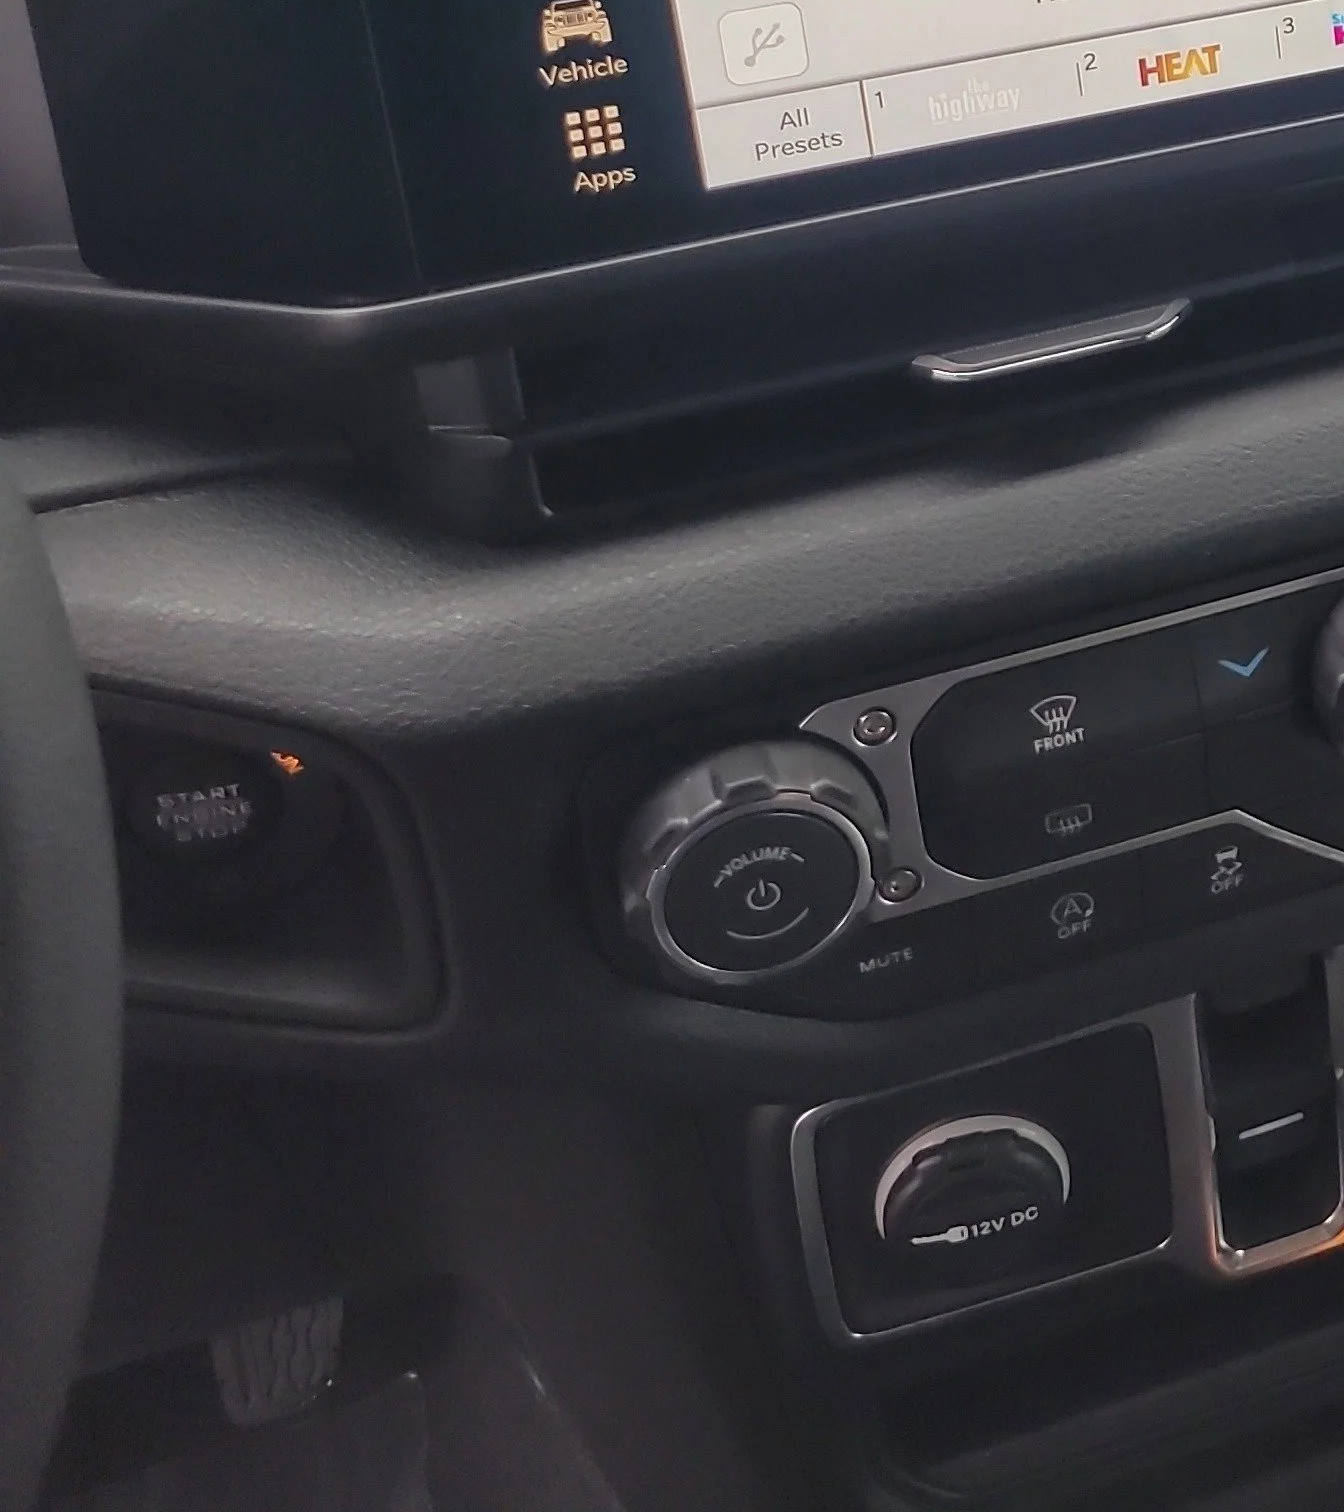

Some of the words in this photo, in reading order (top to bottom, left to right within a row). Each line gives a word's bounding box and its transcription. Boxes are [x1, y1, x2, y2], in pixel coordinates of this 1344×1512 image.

[1282, 17, 1295, 34] 3
[539, 54, 629, 87] Vehicle
[1083, 52, 1099, 71] 2
[1138, 43, 1222, 87] HEAT
[874, 90, 885, 109] 1
[928, 87, 1021, 122] highway
[779, 108, 810, 130] All
[754, 129, 844, 162] Presets
[573, 163, 637, 193] Apps
[1033, 727, 1086, 755] FRONT
[720, 846, 792, 877] VOLUME
[1057, 919, 1092, 939] OFF
[858, 947, 915, 974] MUTE
[970, 1216, 1006, 1238] 12V
[1010, 1206, 1039, 1227] DC
